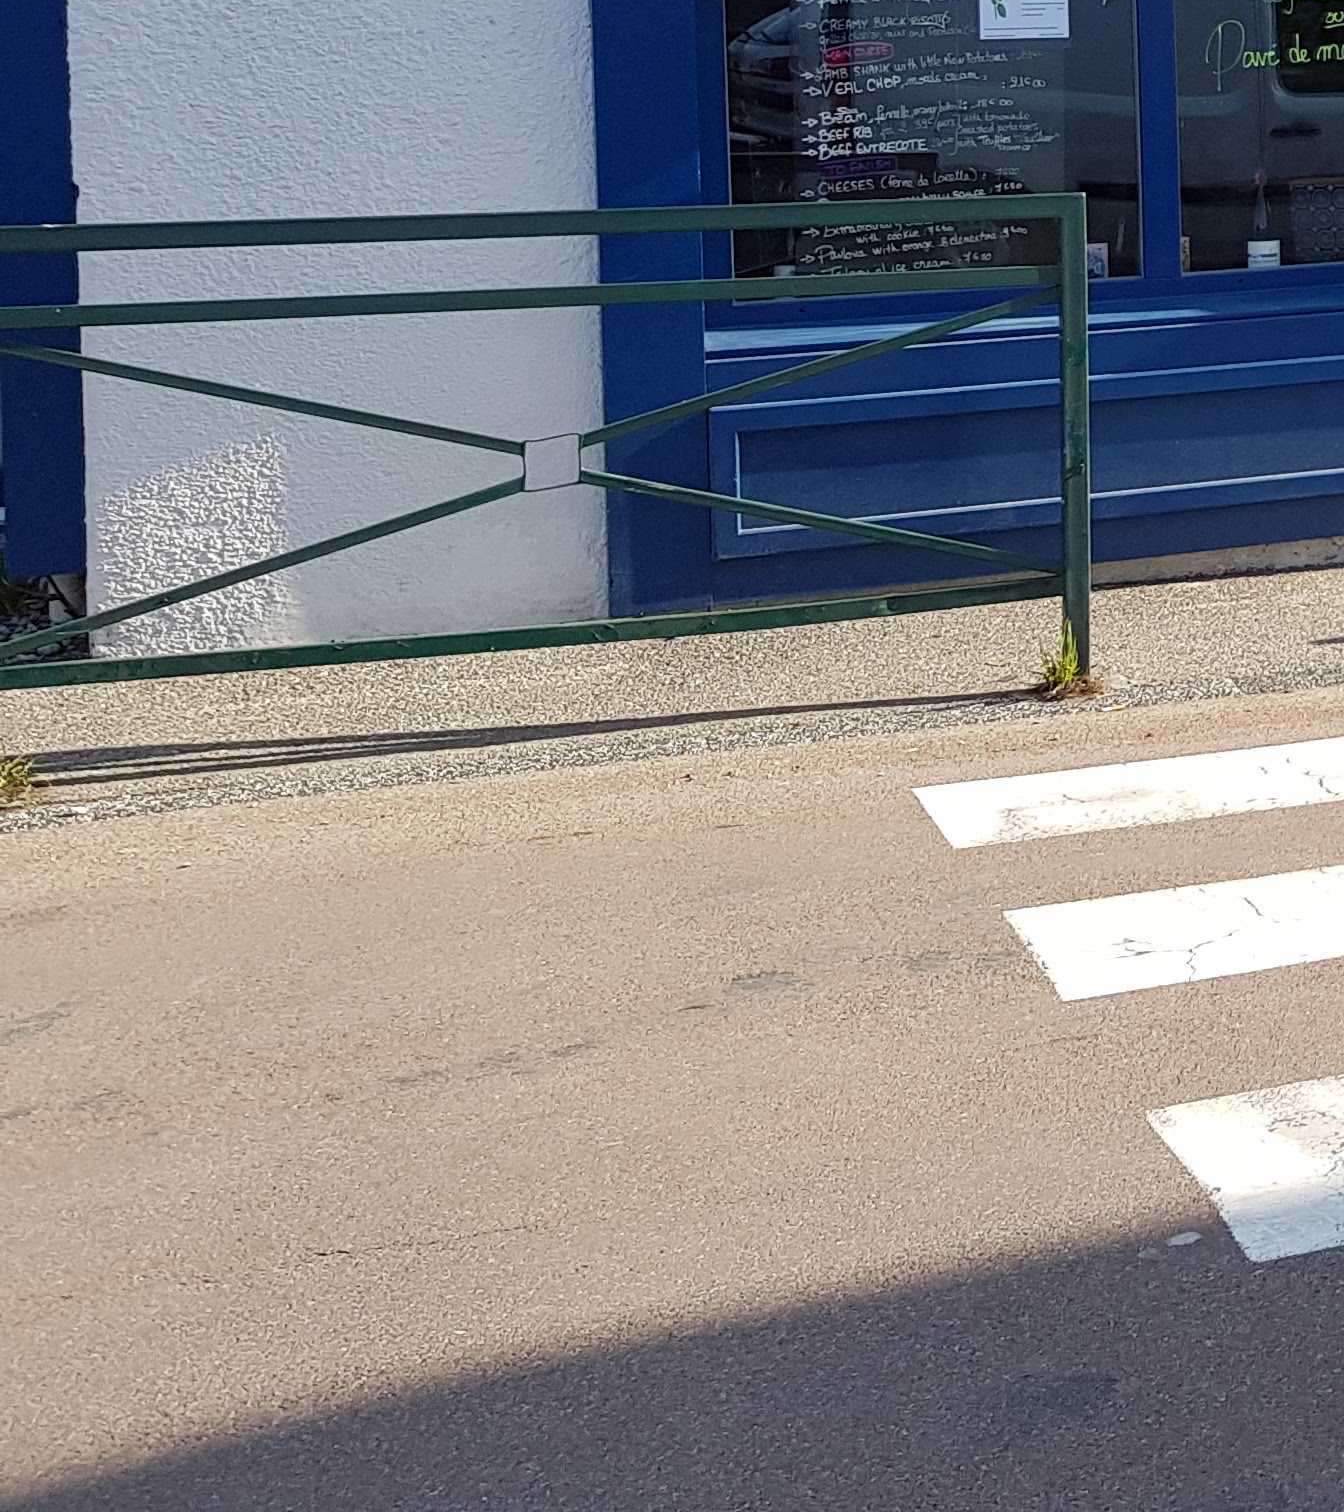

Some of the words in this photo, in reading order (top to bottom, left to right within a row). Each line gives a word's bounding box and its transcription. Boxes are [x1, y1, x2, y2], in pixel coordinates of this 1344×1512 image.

[818, 18, 868, 33] CREAMY
[873, 17, 907, 29] BLACK
[1205, 19, 1280, 92] Pavé
[1288, 33, 1311, 64] de
[853, 63, 891, 77] SHANK
[894, 59, 919, 72] with
[821, 80, 864, 98] VEAL
[818, 128, 850, 142] BEEF
[818, 141, 852, 160] BEEF
[856, 139, 929, 155] ENTRECOTE
[818, 178, 875, 195] CHEESES
[856, 232, 880, 243] with
[886, 229, 921, 241] cookie
[814, 244, 868, 264] Pavlova
[872, 243, 900, 256] with
[913, 259, 953, 270] cream
